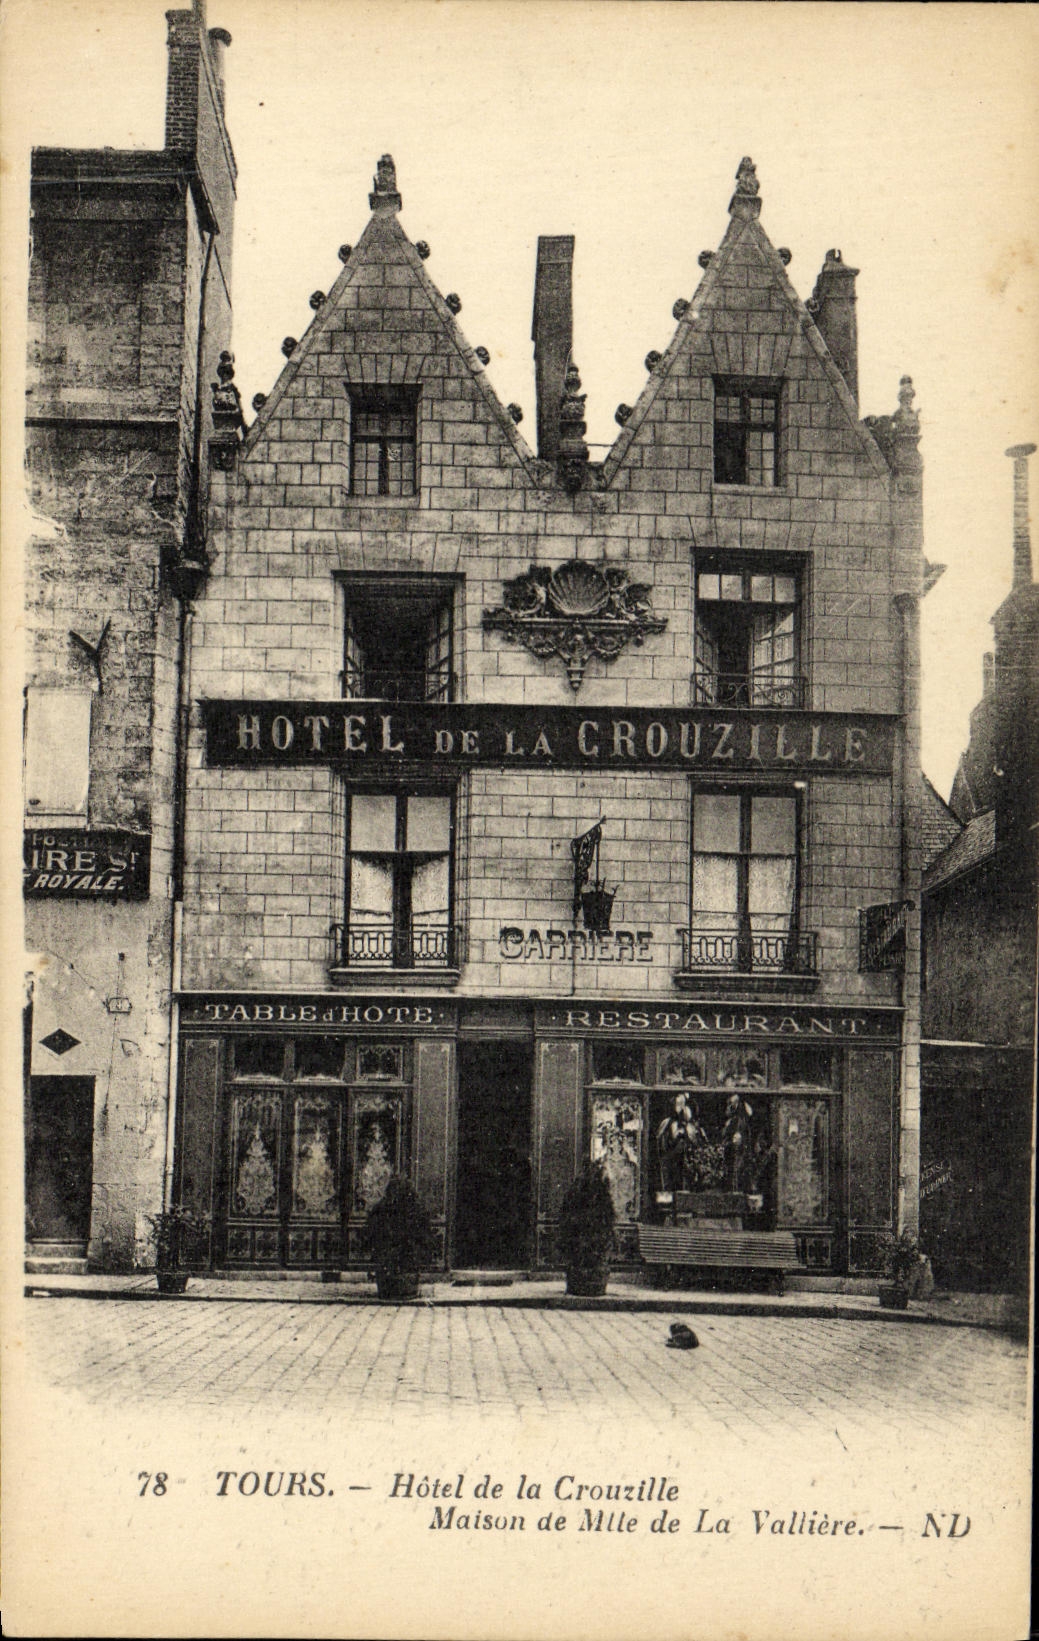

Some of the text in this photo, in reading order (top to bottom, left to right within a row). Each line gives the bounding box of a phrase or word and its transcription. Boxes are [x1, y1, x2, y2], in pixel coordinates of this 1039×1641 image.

[236, 713, 868, 762] HOTEL DE LA CROUZILLE
[204, 1004, 317, 1022] TABLE
[565, 1010, 867, 1034] RESTAURANT
